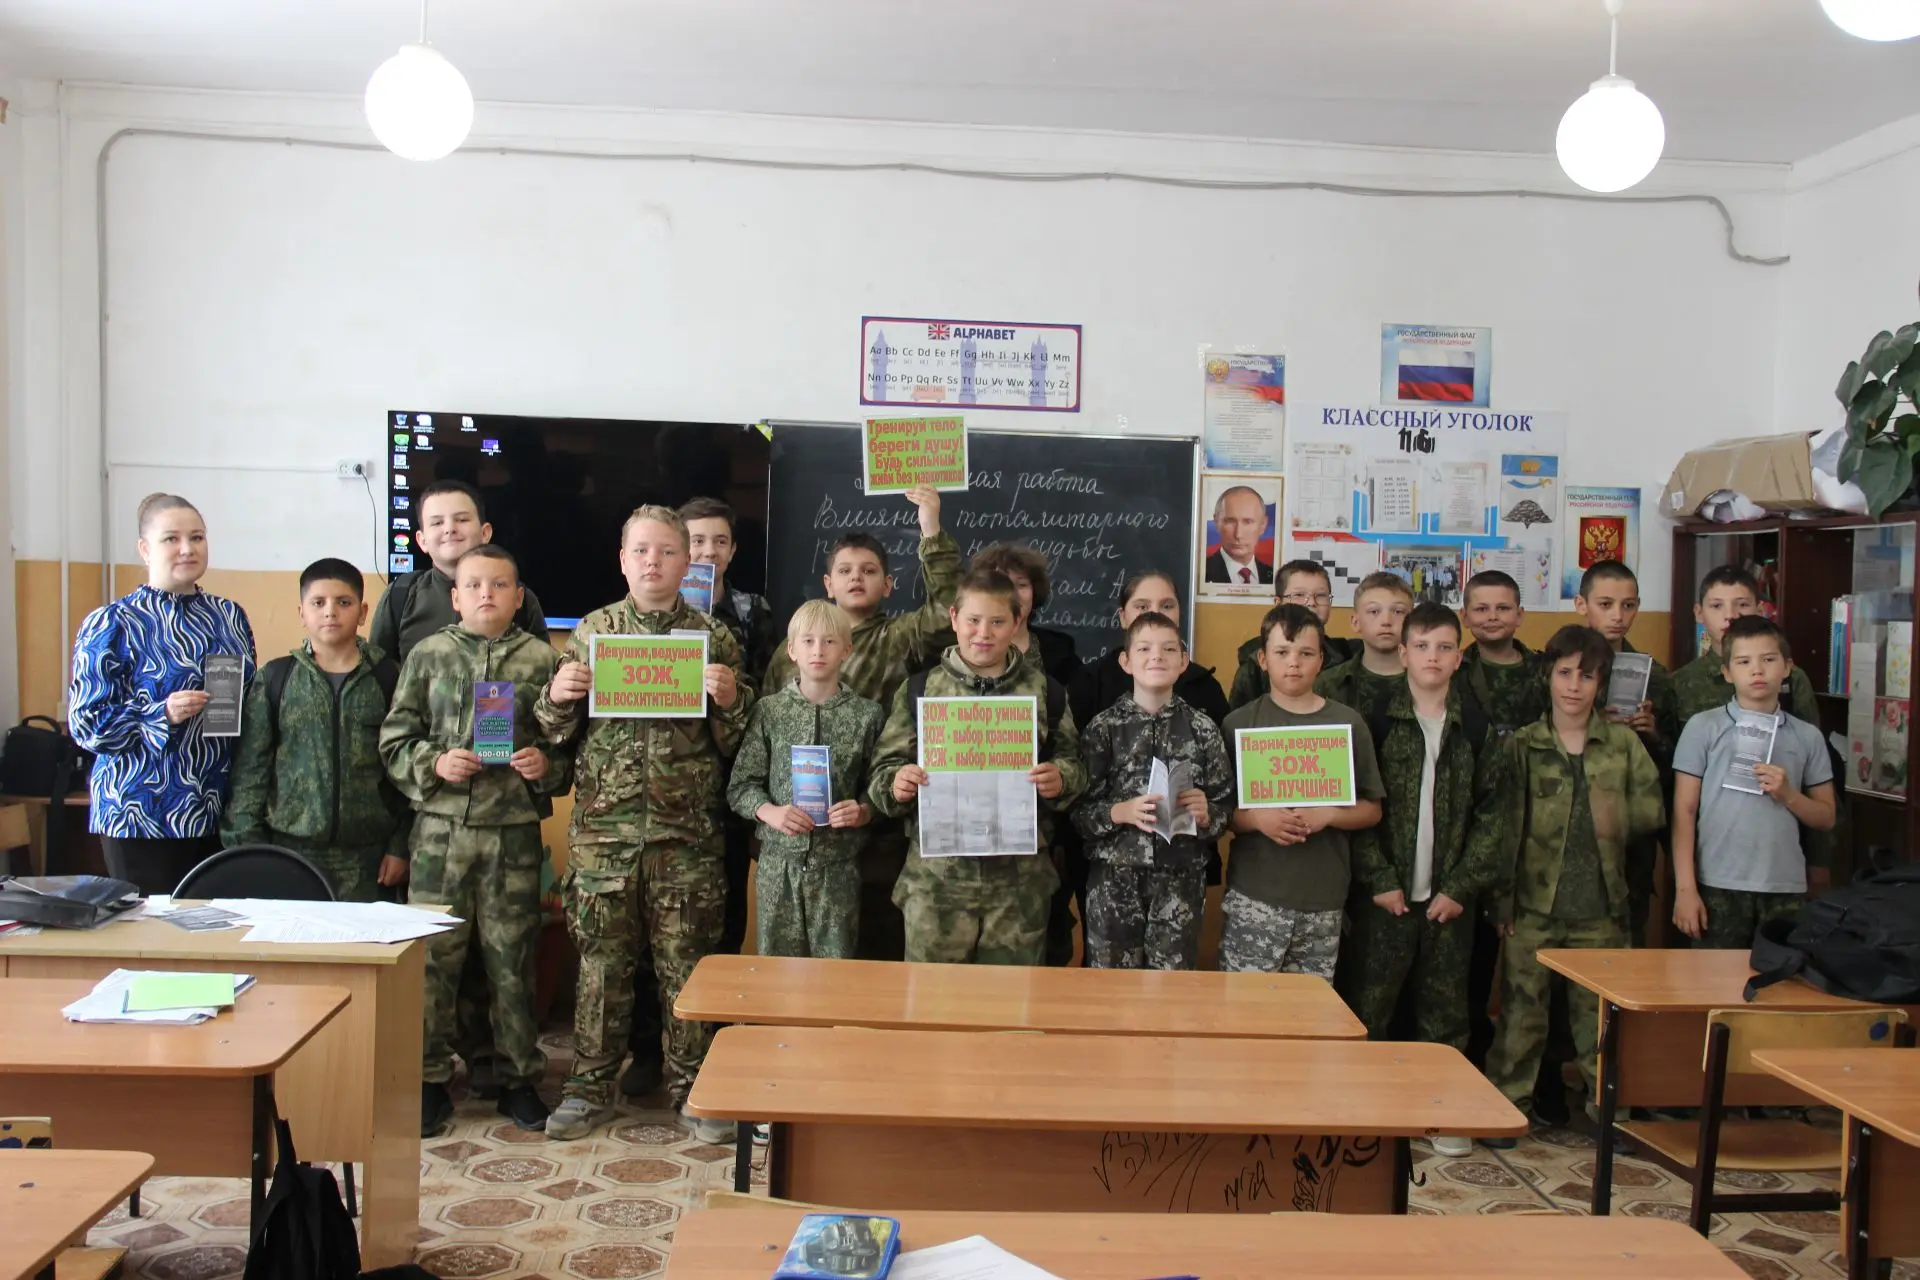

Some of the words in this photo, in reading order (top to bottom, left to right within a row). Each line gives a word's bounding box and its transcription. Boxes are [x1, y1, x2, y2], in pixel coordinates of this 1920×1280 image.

[953, 327, 1016, 340] ALPHABET
[1459, 331, 1476, 339] ФЛАГ
[870, 345, 882, 355] Aa
[885, 346, 898, 356] Bb
[902, 347, 913, 357] Cc
[918, 348, 931, 357] Dd
[934, 349, 946, 358] Ee
[950, 349, 960, 358] Ff
[964, 350, 977, 361] Gg
[981, 350, 995, 360] Hh
[999, 351, 1006, 360] Ii
[1011, 351, 1020, 362] Jj
[1023, 352, 1036, 361] Kk
[1040, 353, 1049, 362] Ll
[1053, 353, 1070, 362] Mm
[868, 373, 881, 382] Nn
[884, 373, 898, 383] Oo
[900, 374, 913, 384] Pp
[916, 374, 930, 385] Qq
[932, 375, 943, 384] Rr
[947, 376, 958, 385] Ss
[962, 376, 971, 385] Tt
[975, 377, 988, 385] Uu
[991, 378, 1003, 386] Vv
[1007, 378, 1024, 387] Ww
[1028, 379, 1040, 388] Xx
[1044, 379, 1055, 389] Yy
[1058, 380, 1069, 389] Zz
[867, 416, 927, 438] Тренируй
[929, 420, 956, 432] тело
[1321, 407, 1442, 429] КЛАССНЫЙ
[1447, 411, 1534, 432] УГОЛОК
[868, 437, 920, 456] береги
[924, 434, 964, 454] душу!
[874, 453, 903, 472] Будь
[906, 453, 955, 468] сильным
[871, 473, 894, 486] живи
[896, 471, 913, 484] без
[914, 465, 965, 484] наркотиков!
[1010, 468, 1104, 513] работа
[956, 508, 1169, 545] тоталитарного
[622, 664, 680, 689] ЗОЖ,
[595, 691, 611, 706] ВЫ
[613, 691, 702, 707] ВОСХИТИТЕЛЬНЫ!
[923, 703, 948, 722] ЗОЖ
[957, 702, 992, 726] выбор
[995, 706, 1032, 725] умных
[923, 725, 945, 744] ЗОЖ
[953, 724, 983, 749] выбор
[985, 729, 1032, 749] красивых
[923, 747, 947, 768] ЗОЖ
[955, 746, 986, 770] выбор
[988, 751, 1032, 770] молодых
[1269, 754, 1326, 778] ЗОЖ,
[1250, 780, 1274, 800] ВЫ
[1276, 778, 1342, 799] ЛУЧШИЕ!
